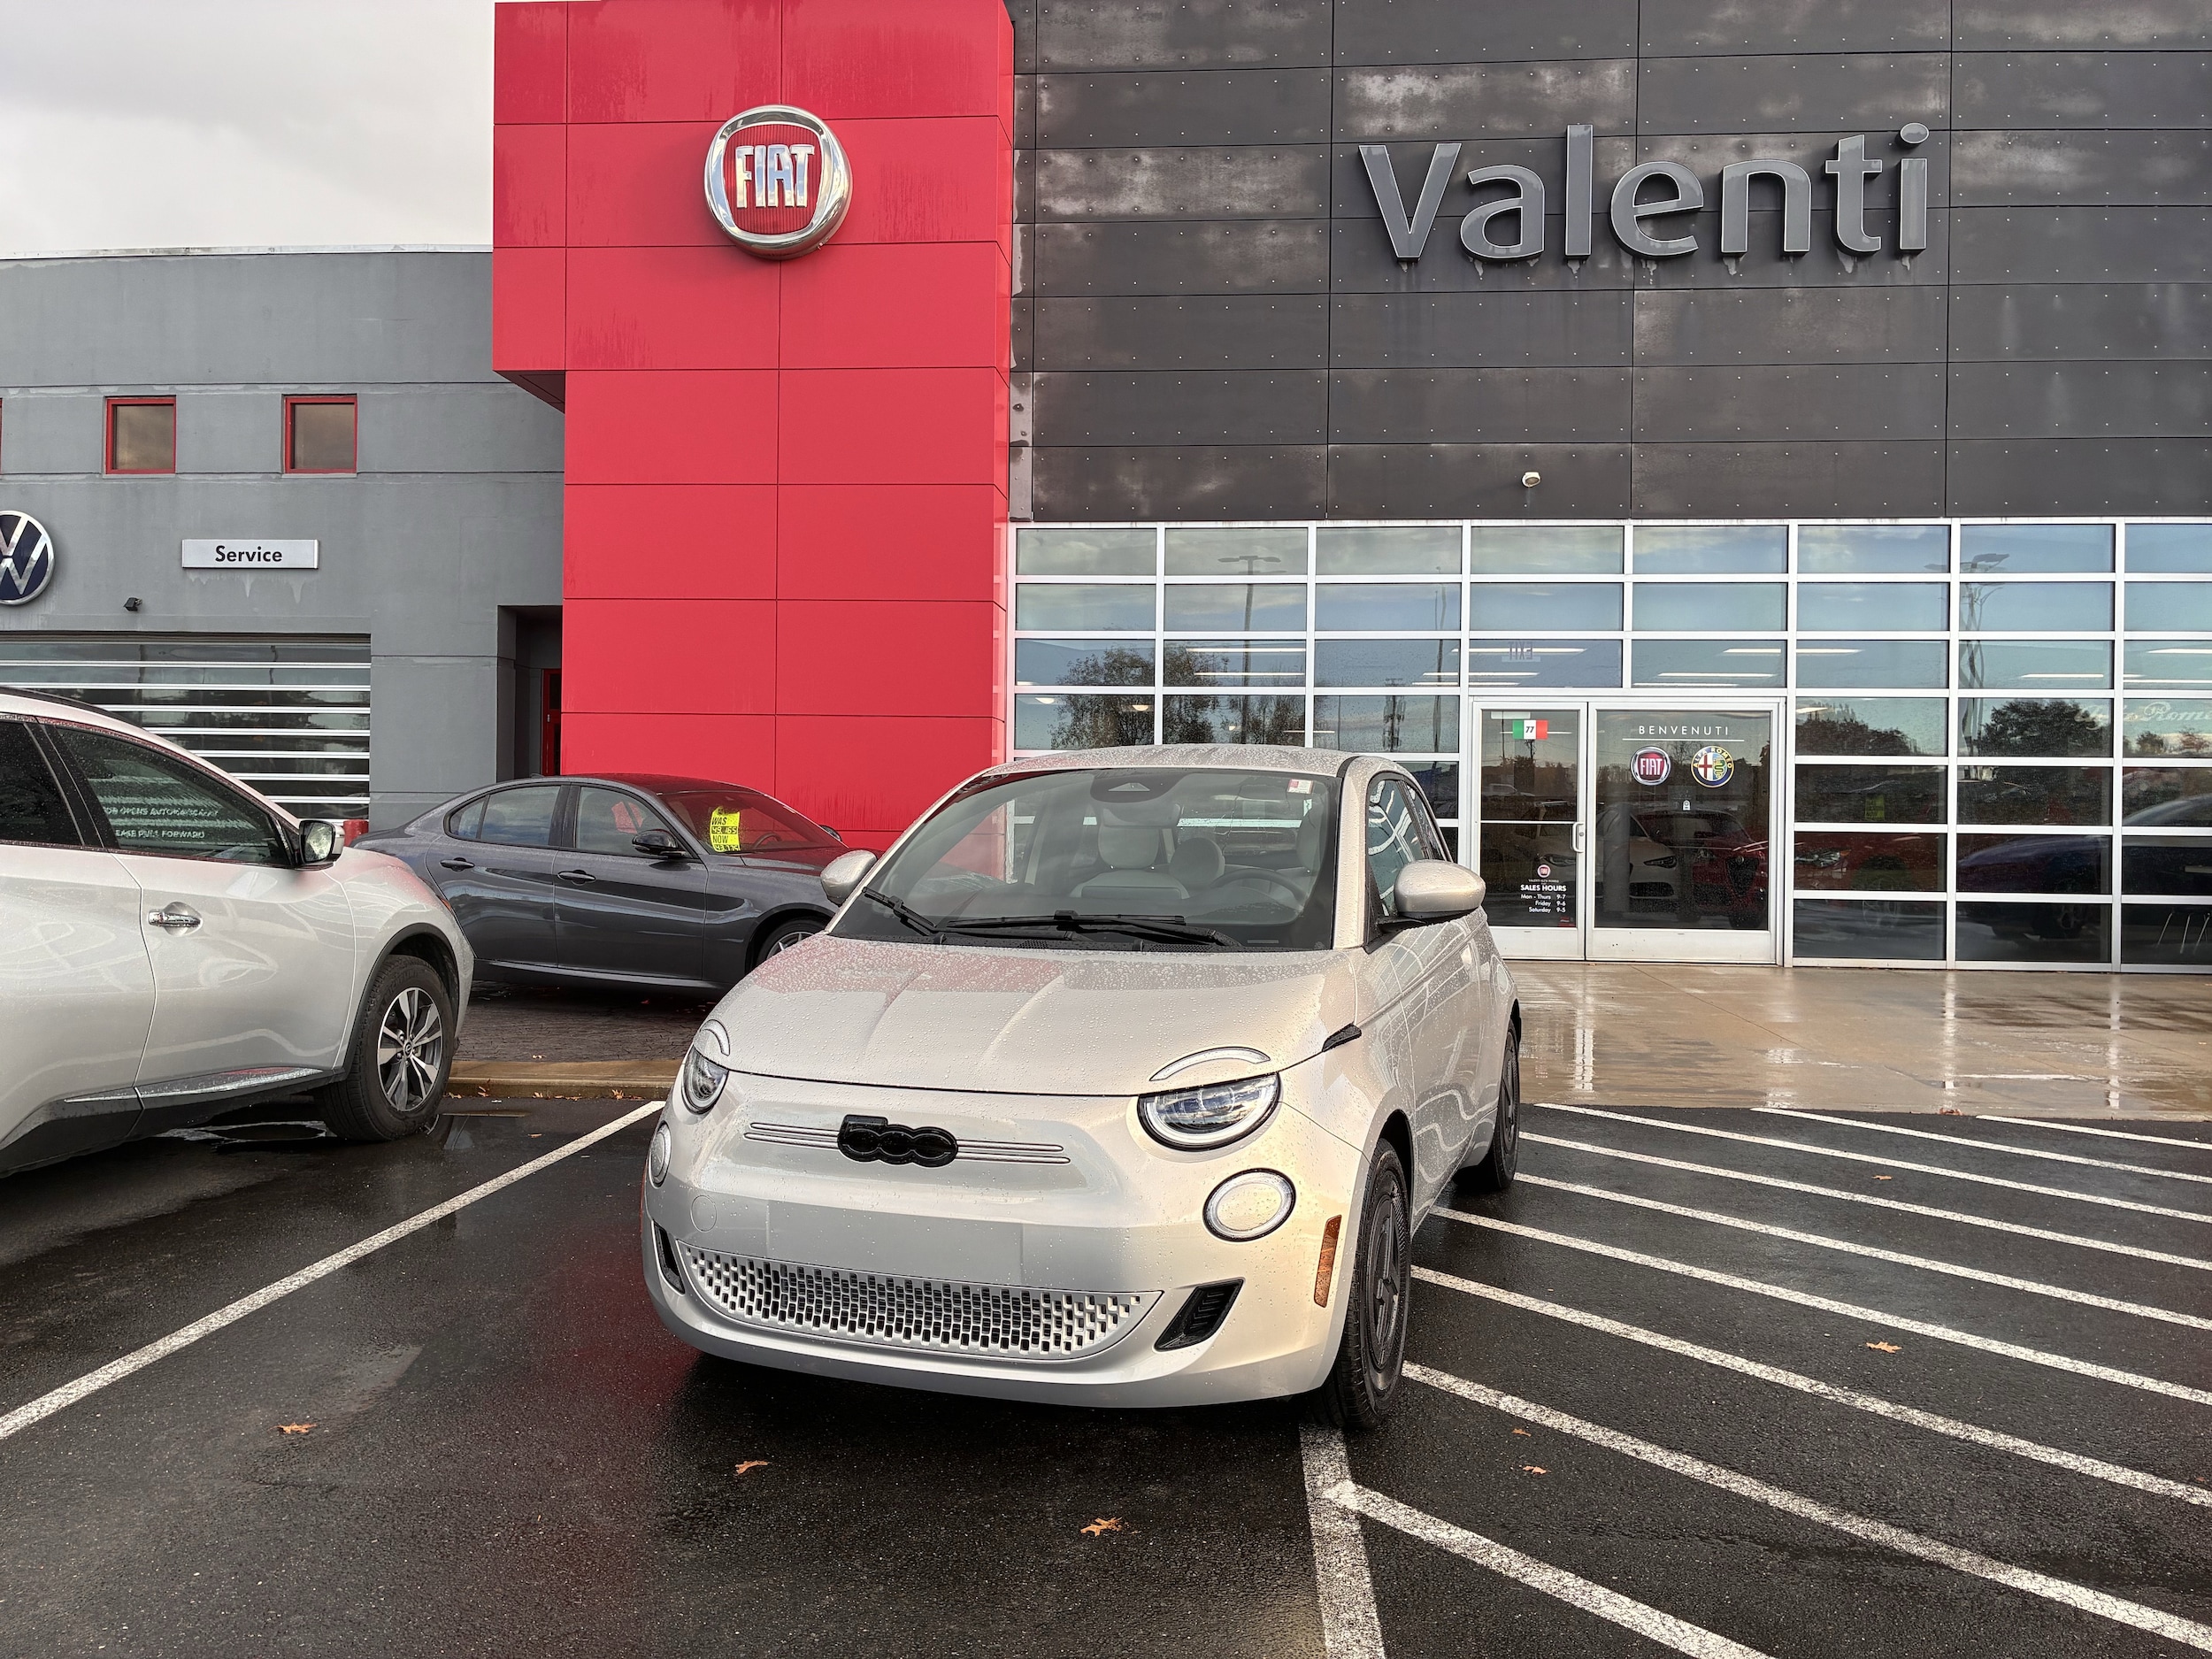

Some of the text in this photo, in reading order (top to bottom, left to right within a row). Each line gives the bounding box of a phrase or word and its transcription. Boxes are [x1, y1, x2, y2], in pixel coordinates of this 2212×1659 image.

[735, 144, 815, 209] FIAT
[1358, 122, 1930, 260] Valenti
[215, 545, 283, 563] Service
[1639, 725, 1728, 735] BENVENUTI
[1640, 757, 1663, 775] FIAT
[1693, 747, 1733, 769] ALFA ROMEO
[711, 817, 727, 826] WAS
[161, 830, 205, 839] FORWARD
[712, 834, 729, 844] NOW
[837, 1113, 958, 1168] 500
